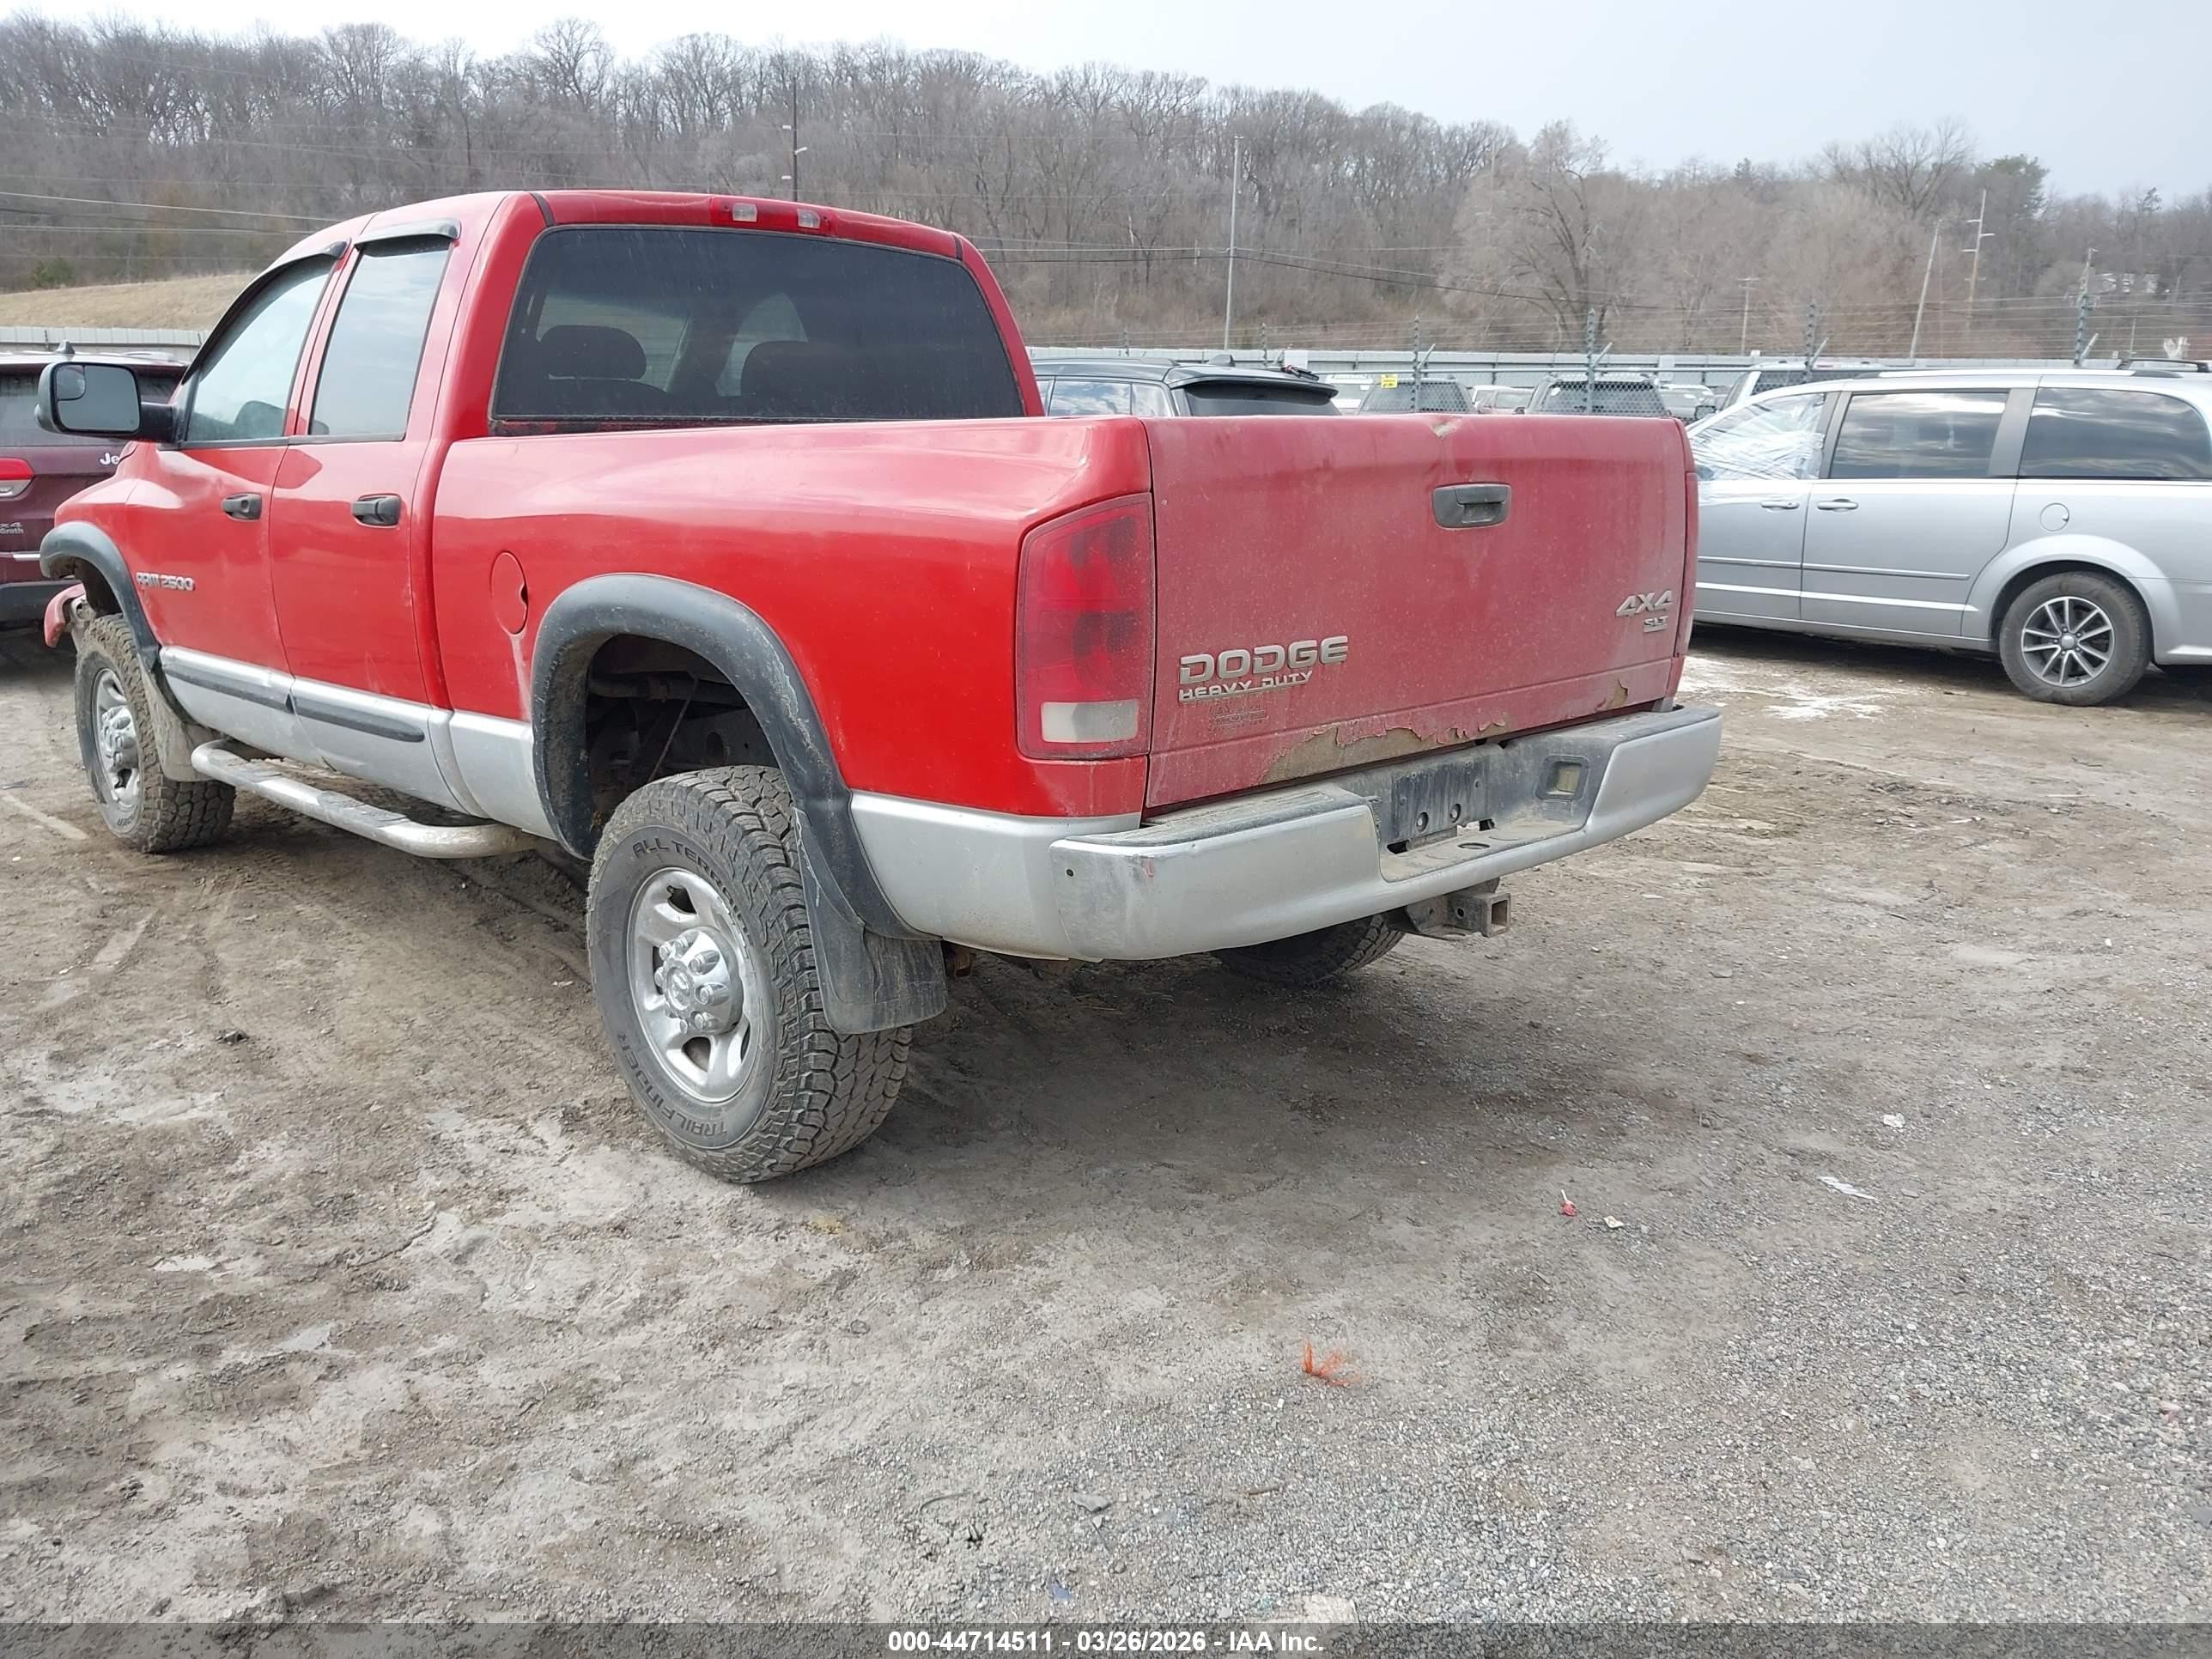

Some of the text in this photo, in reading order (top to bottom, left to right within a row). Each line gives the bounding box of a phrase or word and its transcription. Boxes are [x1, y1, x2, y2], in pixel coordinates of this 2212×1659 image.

[136, 571, 194, 592] RAM 2500
[1643, 615, 1668, 629] SLT
[1179, 635, 1348, 685] DODGE
[1178, 670, 1313, 702] HEAVY DUTY
[632, 837, 669, 859] ALL
[617, 1033, 727, 1137] TRAILFINDER
